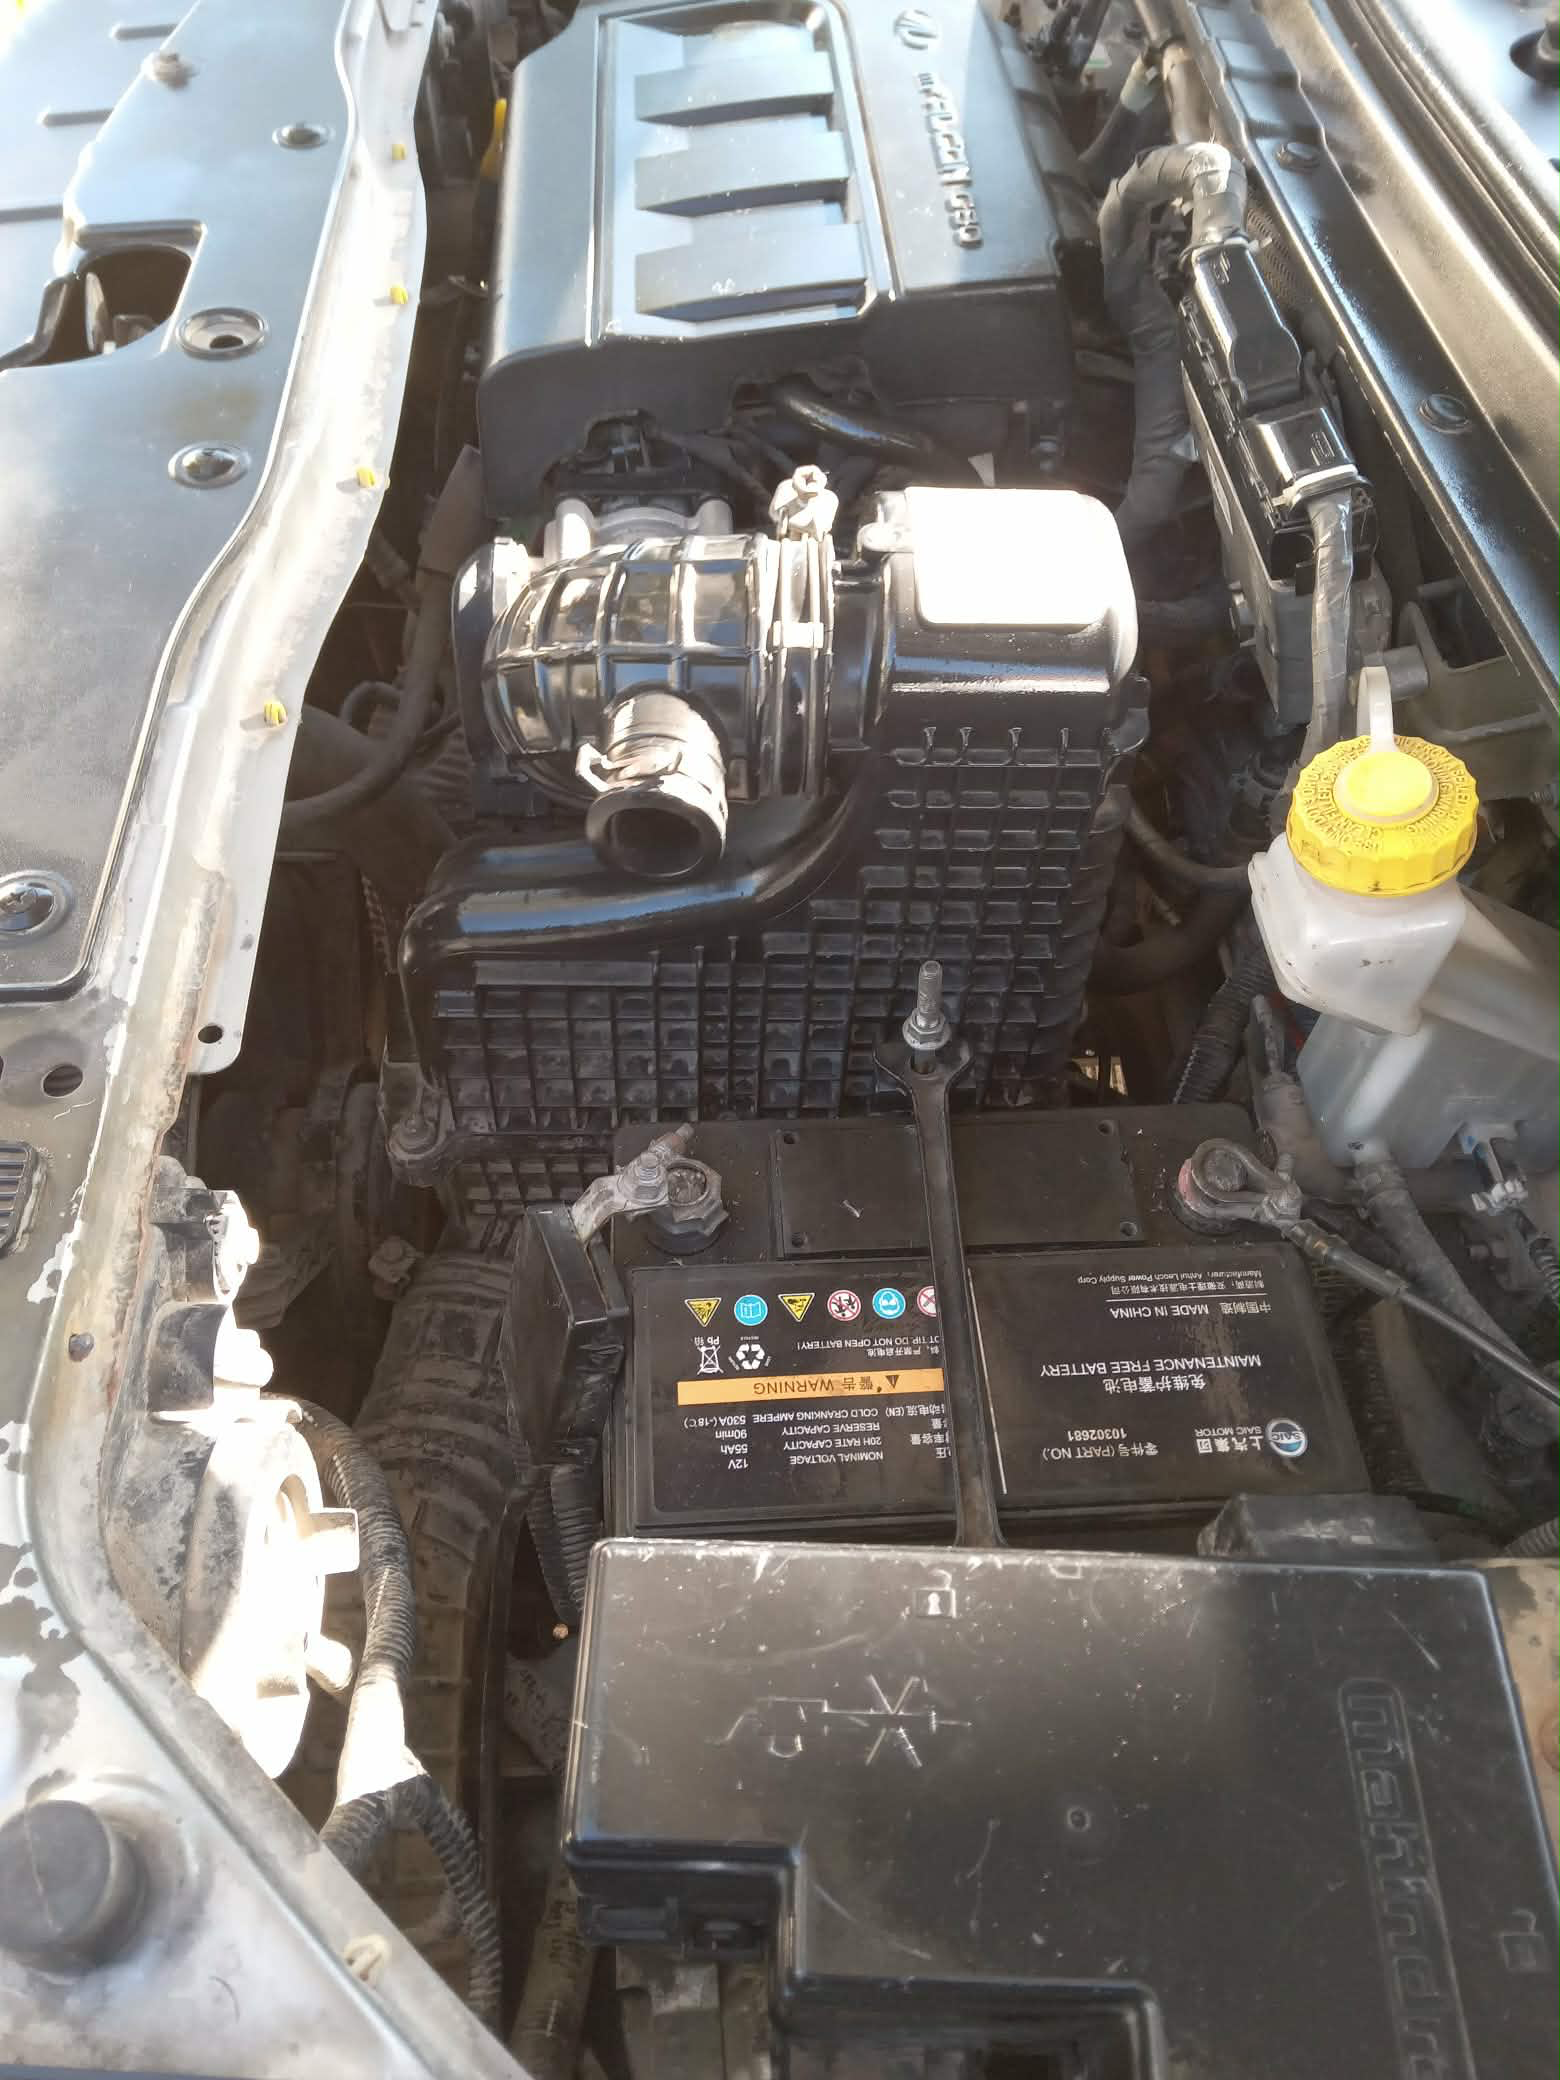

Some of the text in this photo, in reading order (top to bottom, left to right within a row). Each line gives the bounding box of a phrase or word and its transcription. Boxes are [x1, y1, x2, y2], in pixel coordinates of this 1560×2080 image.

[1099, 1273, 1126, 1284] Supply
[1128, 1274, 1152, 1283] Power
[1110, 1301, 1271, 1319] 中国制造 MADE IN CHINA
[707, 1336, 720, 1345] Pb
[844, 1338, 871, 1347] OPEN
[873, 1338, 893, 1347] NOT
[895, 1337, 909, 1346] DO
[1040, 1354, 1260, 1376] MAINTENANCE FREE BATTERY
[753, 1376, 873, 1395] 警告 WARNING
[1103, 1373, 1205, 1394] 免维护蓄电池
[753, 1408, 878, 1424] COLD CRANKING AMPERE
[715, 1429, 746, 1440] 90min
[782, 1422, 879, 1435] RESERVE CAPACITY
[1067, 1428, 1127, 1441] 10302681
[1195, 1426, 1261, 1438] SAIC MOTOR
[910, 1432, 949, 1445] 率容量
[1271, 1431, 1303, 1441] SAIC
[721, 1443, 748, 1454] 55Ah
[784, 1436, 881, 1450] 20H RATE CAPACITY
[1197, 1435, 1263, 1454] 上汽集团
[728, 1458, 748, 1469] 12V
[790, 1451, 883, 1464] NOMINAL VOLTAGE
